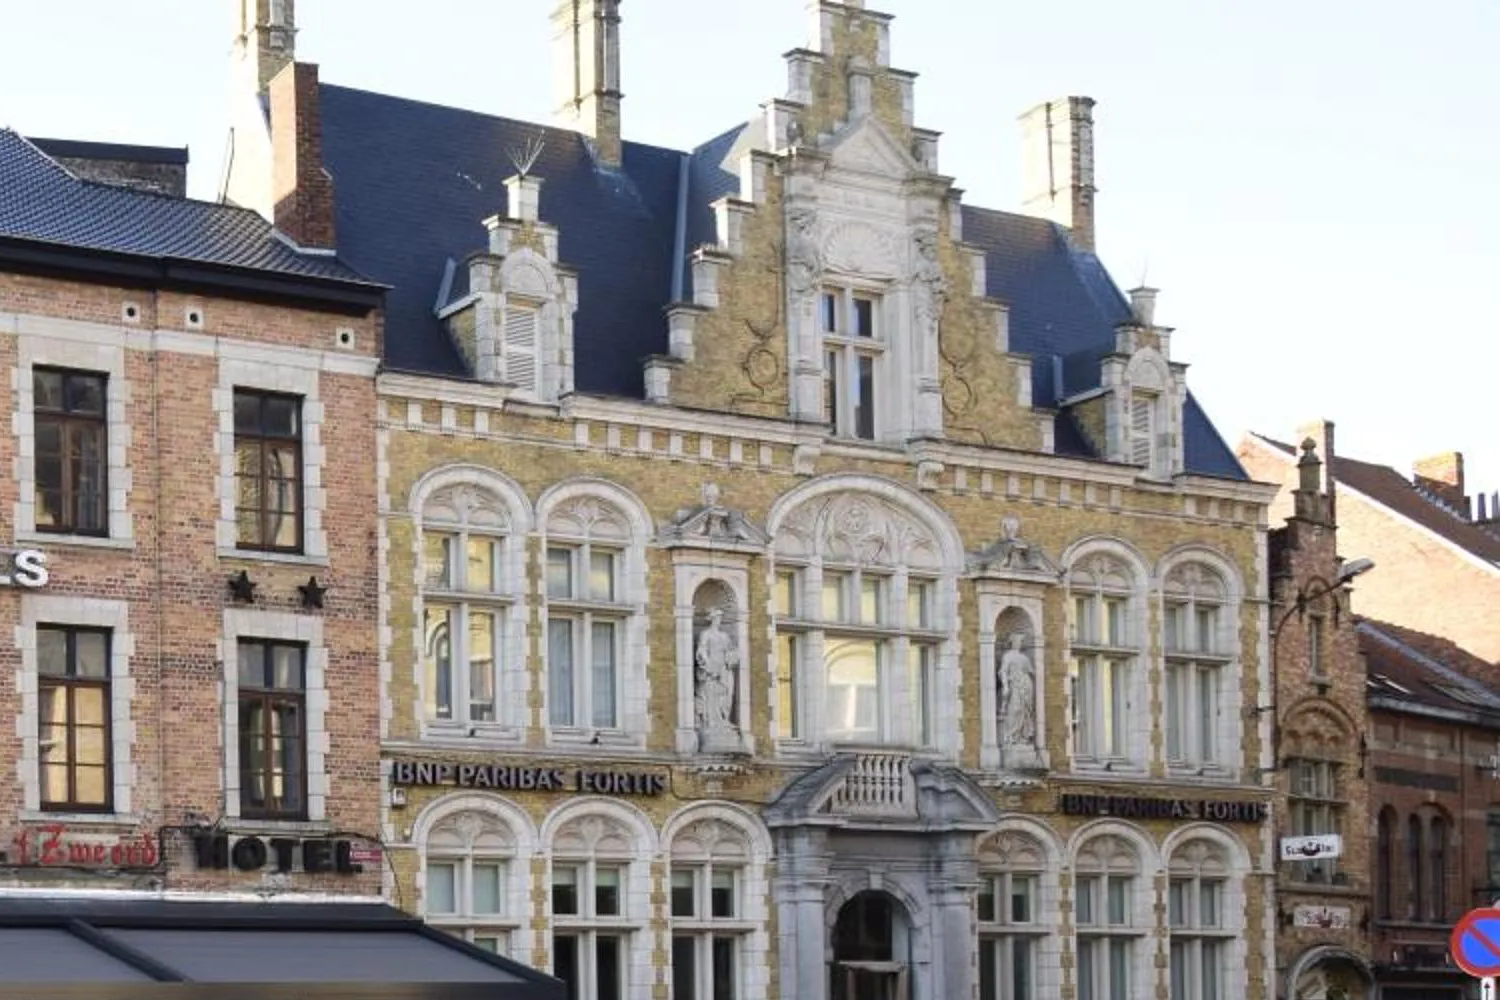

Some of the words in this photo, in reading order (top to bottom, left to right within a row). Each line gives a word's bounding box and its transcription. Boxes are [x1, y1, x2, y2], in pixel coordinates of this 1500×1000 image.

[394, 760, 452, 786] BNP
[456, 763, 565, 791] PARIBAS
[576, 769, 668, 797] FORTIS
[1064, 794, 1107, 815] BNP
[1109, 796, 1194, 818] PARIBAS
[1202, 799, 1270, 821] FORTIS
[193, 832, 363, 875] HOTEL
